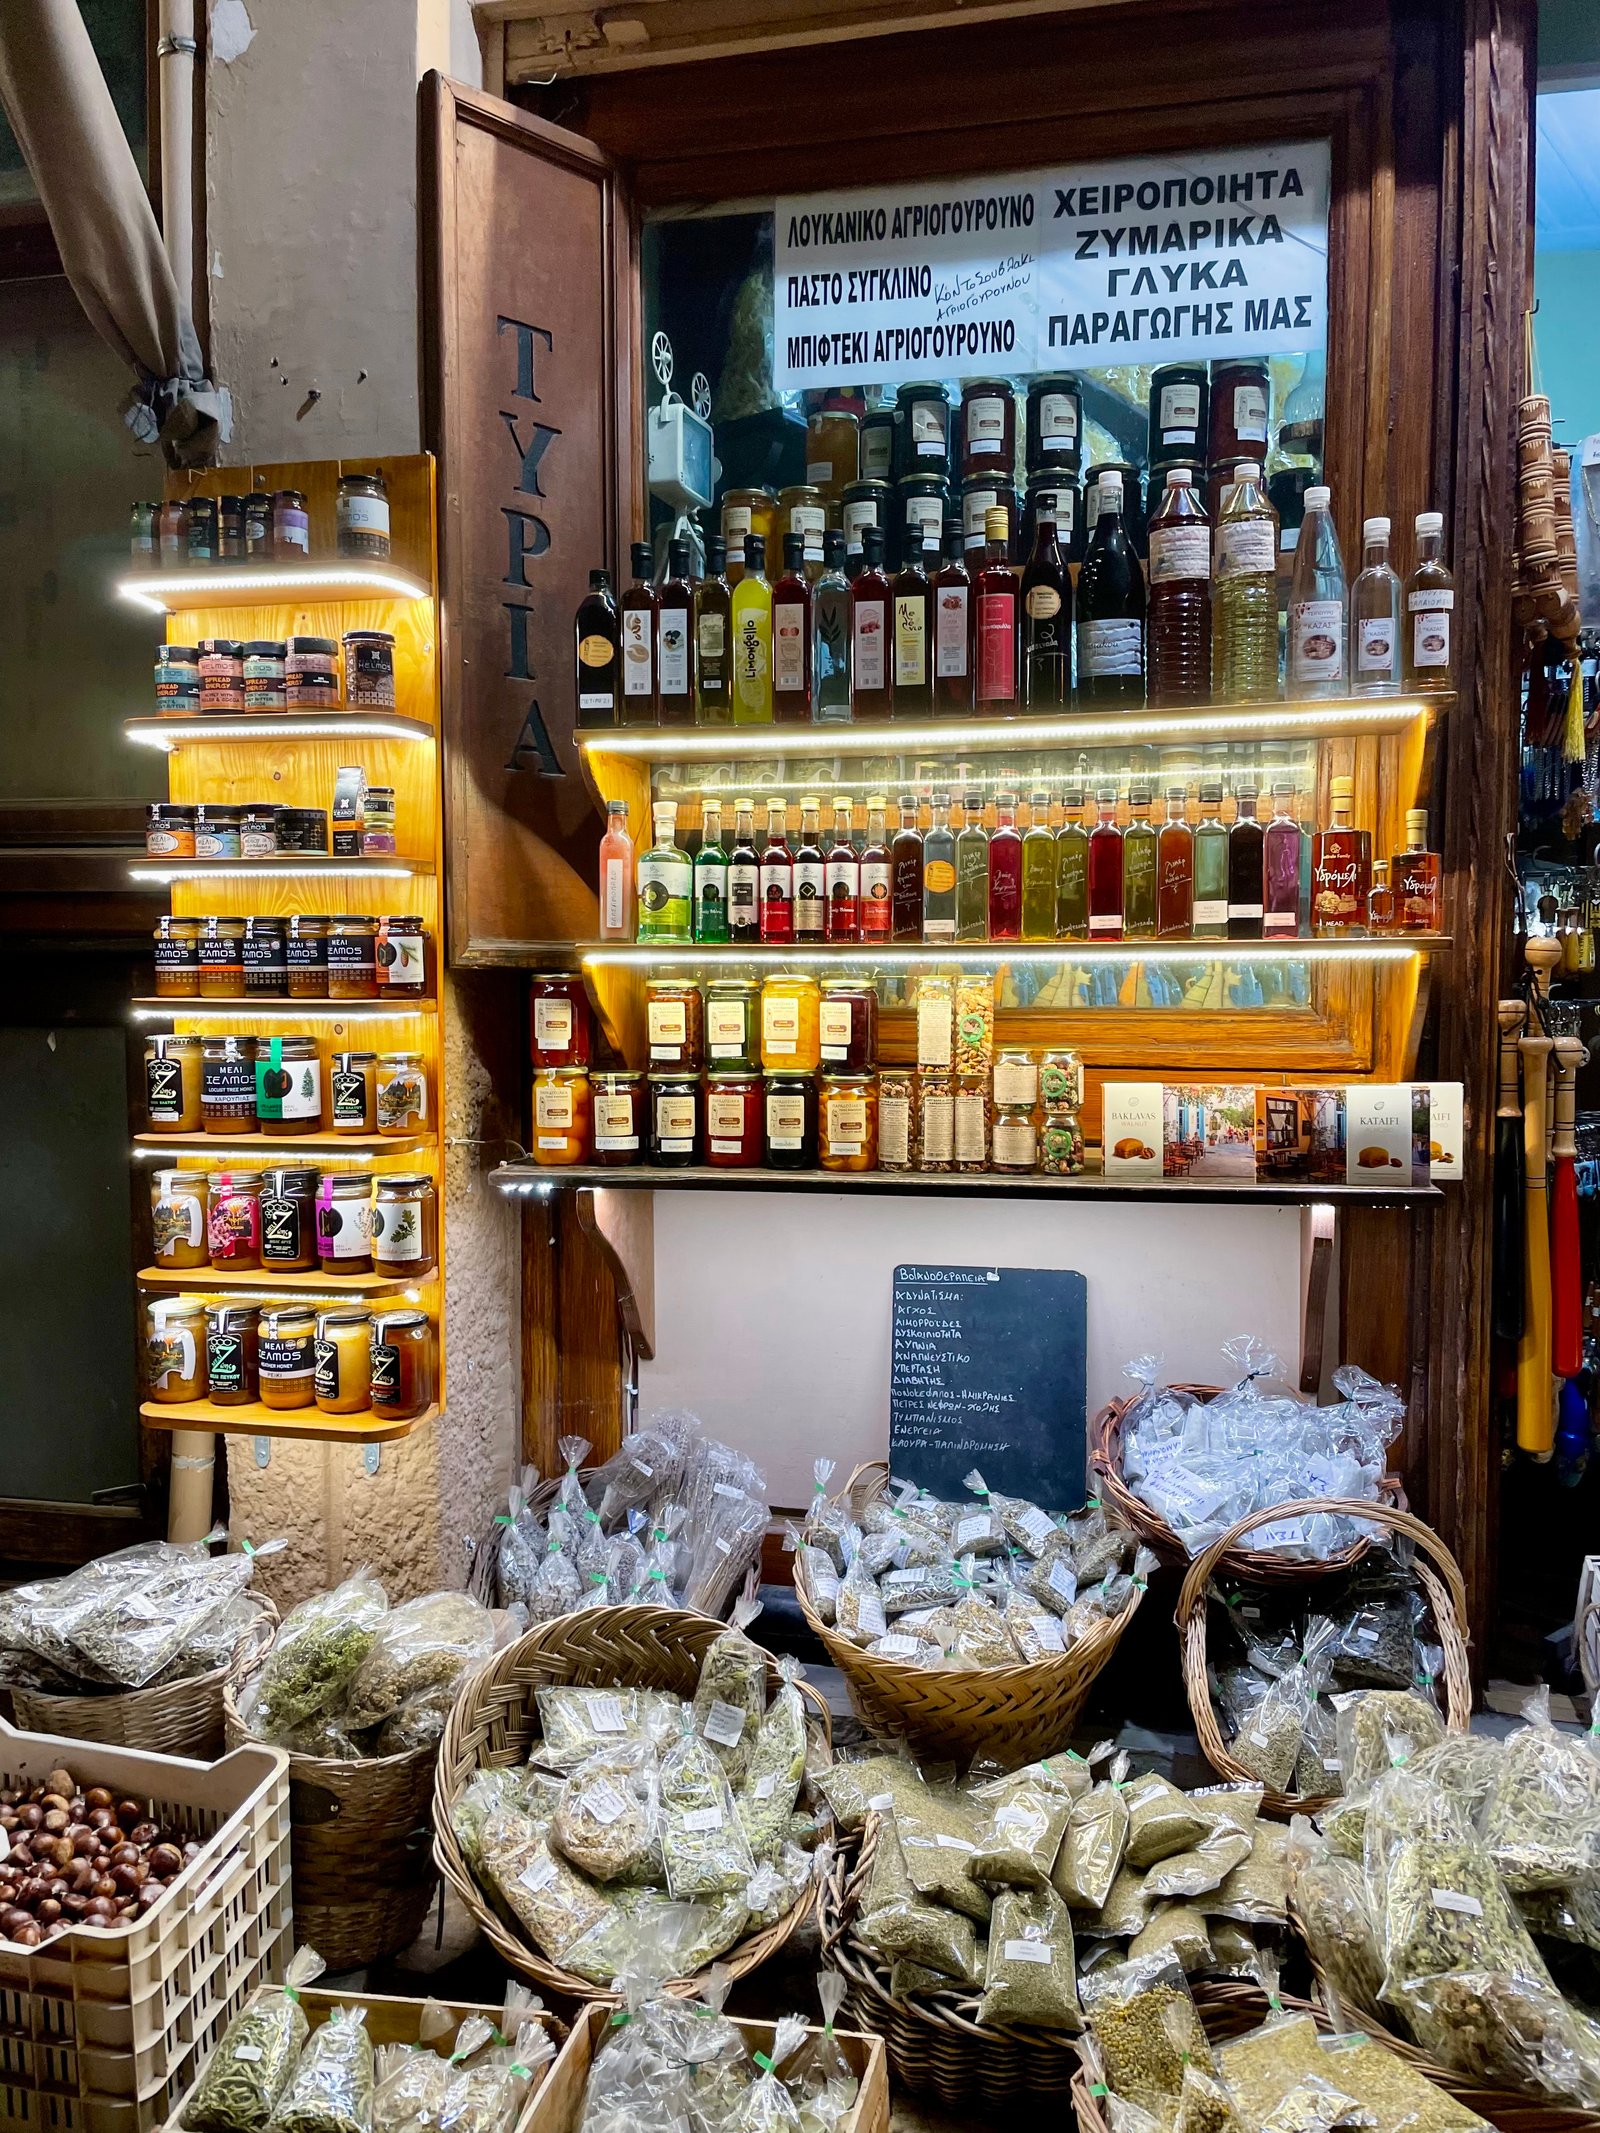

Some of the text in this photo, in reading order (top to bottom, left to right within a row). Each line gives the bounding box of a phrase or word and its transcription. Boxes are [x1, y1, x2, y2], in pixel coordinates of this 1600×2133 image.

[1053, 168, 1304, 219] ΧΕΙΡΟΠΟΙΗΤΑ
[787, 193, 1035, 248] ΛΟΥΚΑΝΙΚΟ ΑΓΡΙΟΓΟΥΡΟΥΝΟ
[1074, 214, 1284, 261] ΖΥΜΑΡΙΚΑ
[787, 265, 932, 308] ΠΑΣΤΟ ΣΥΓΚΛΙΝΟ
[1108, 259, 1249, 298] ΓΛΥΚΑ
[787, 318, 1015, 369] ΜΠΙΦΤΕΚΙ ΑΓΡΙΟΓΟΥΡΟΥΝΟ
[1048, 295, 1312, 348] ΠΑΡΑΓΩΓΗΣ ΜΑΣ
[744, 619, 759, 678] Limongello
[1314, 863, 1357, 888] Υδρόμελι
[1111, 1112, 1156, 1120] BAKLAVAS
[1360, 1117, 1399, 1125] KATAIFI
[264, 1342, 284, 1350] ΜΕΛΙ
